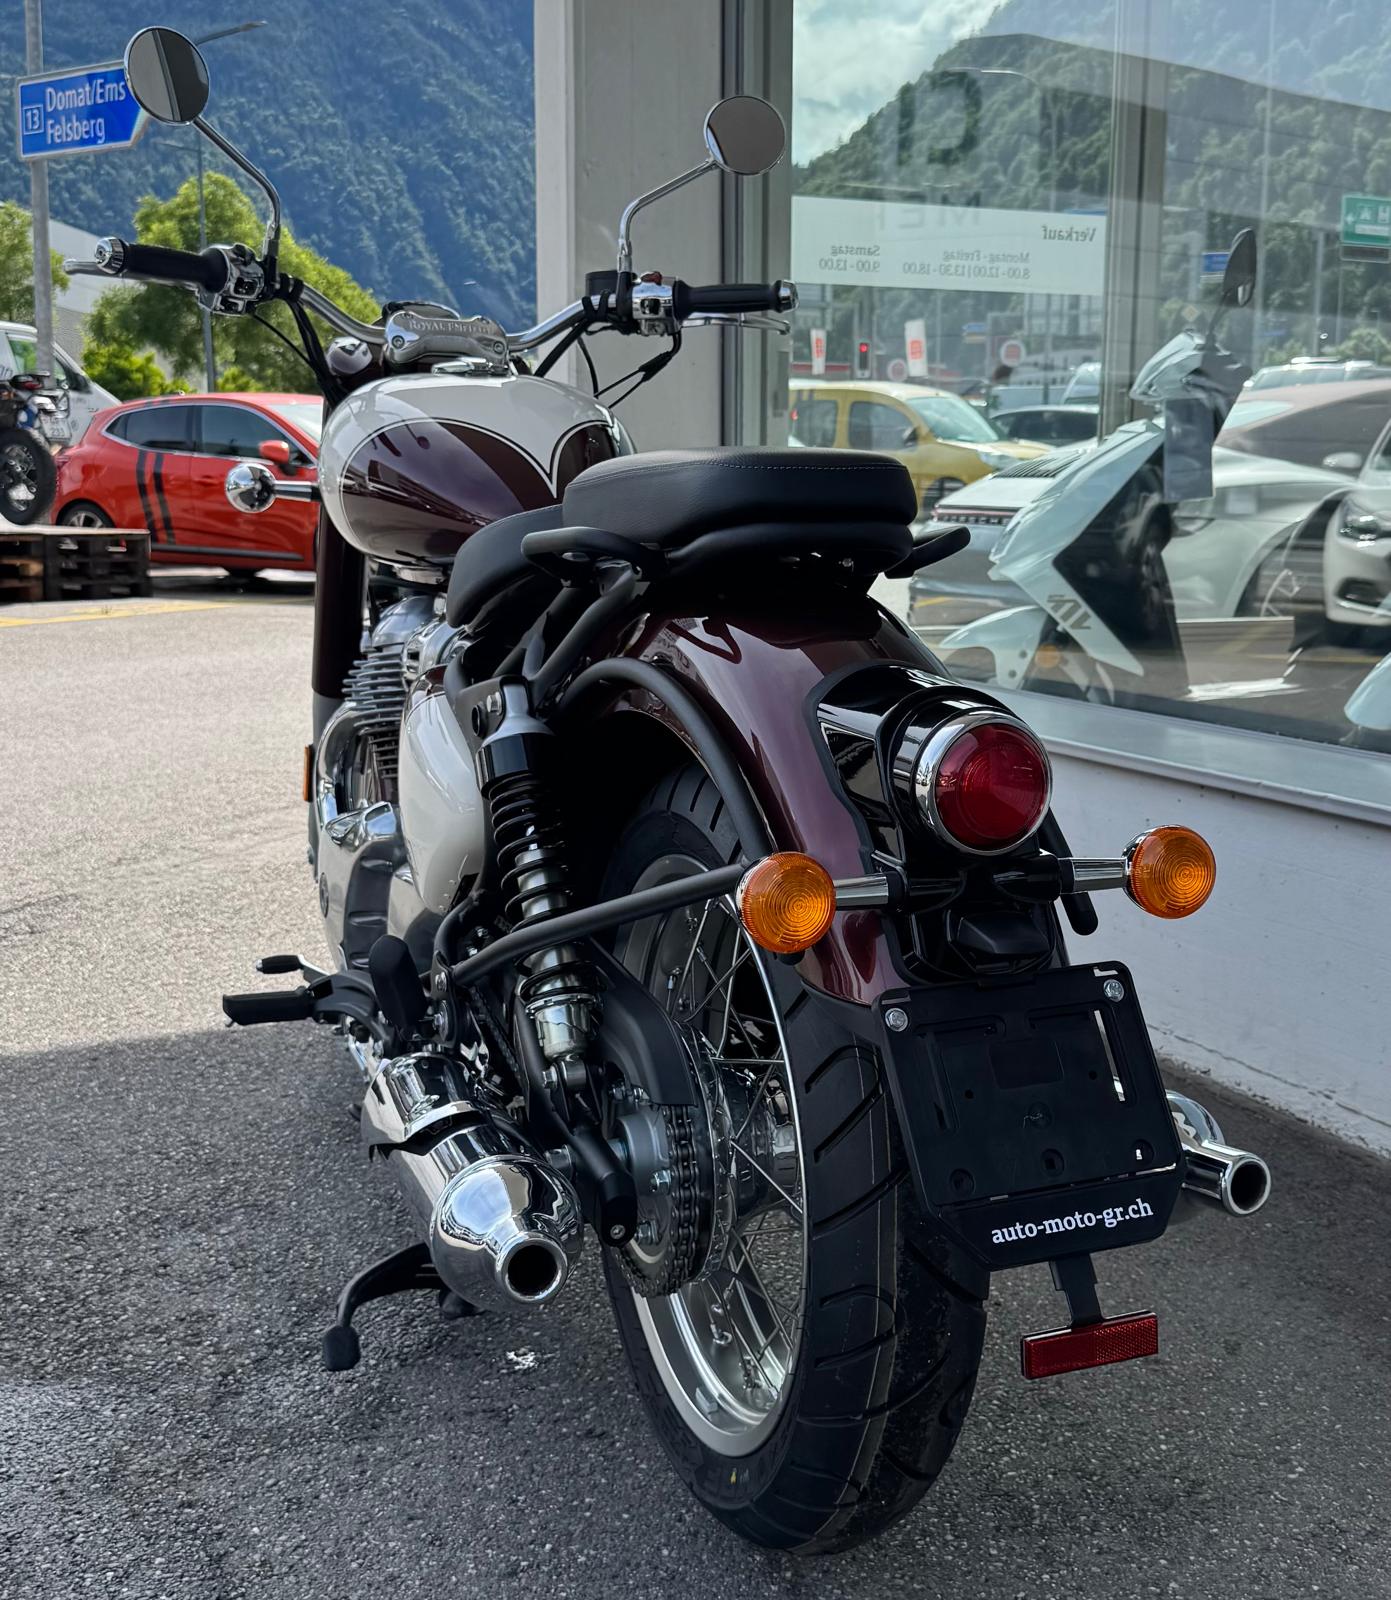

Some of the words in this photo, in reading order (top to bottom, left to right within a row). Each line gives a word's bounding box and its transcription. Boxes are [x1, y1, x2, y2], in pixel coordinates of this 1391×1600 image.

[45, 79, 126, 112] Domat/Ems
[25, 109, 40, 130] 13
[47, 115, 105, 144] Felsberg
[408, 319, 446, 332] ROYAL
[990, 1197, 1154, 1244] auto-moto-gr.ch
